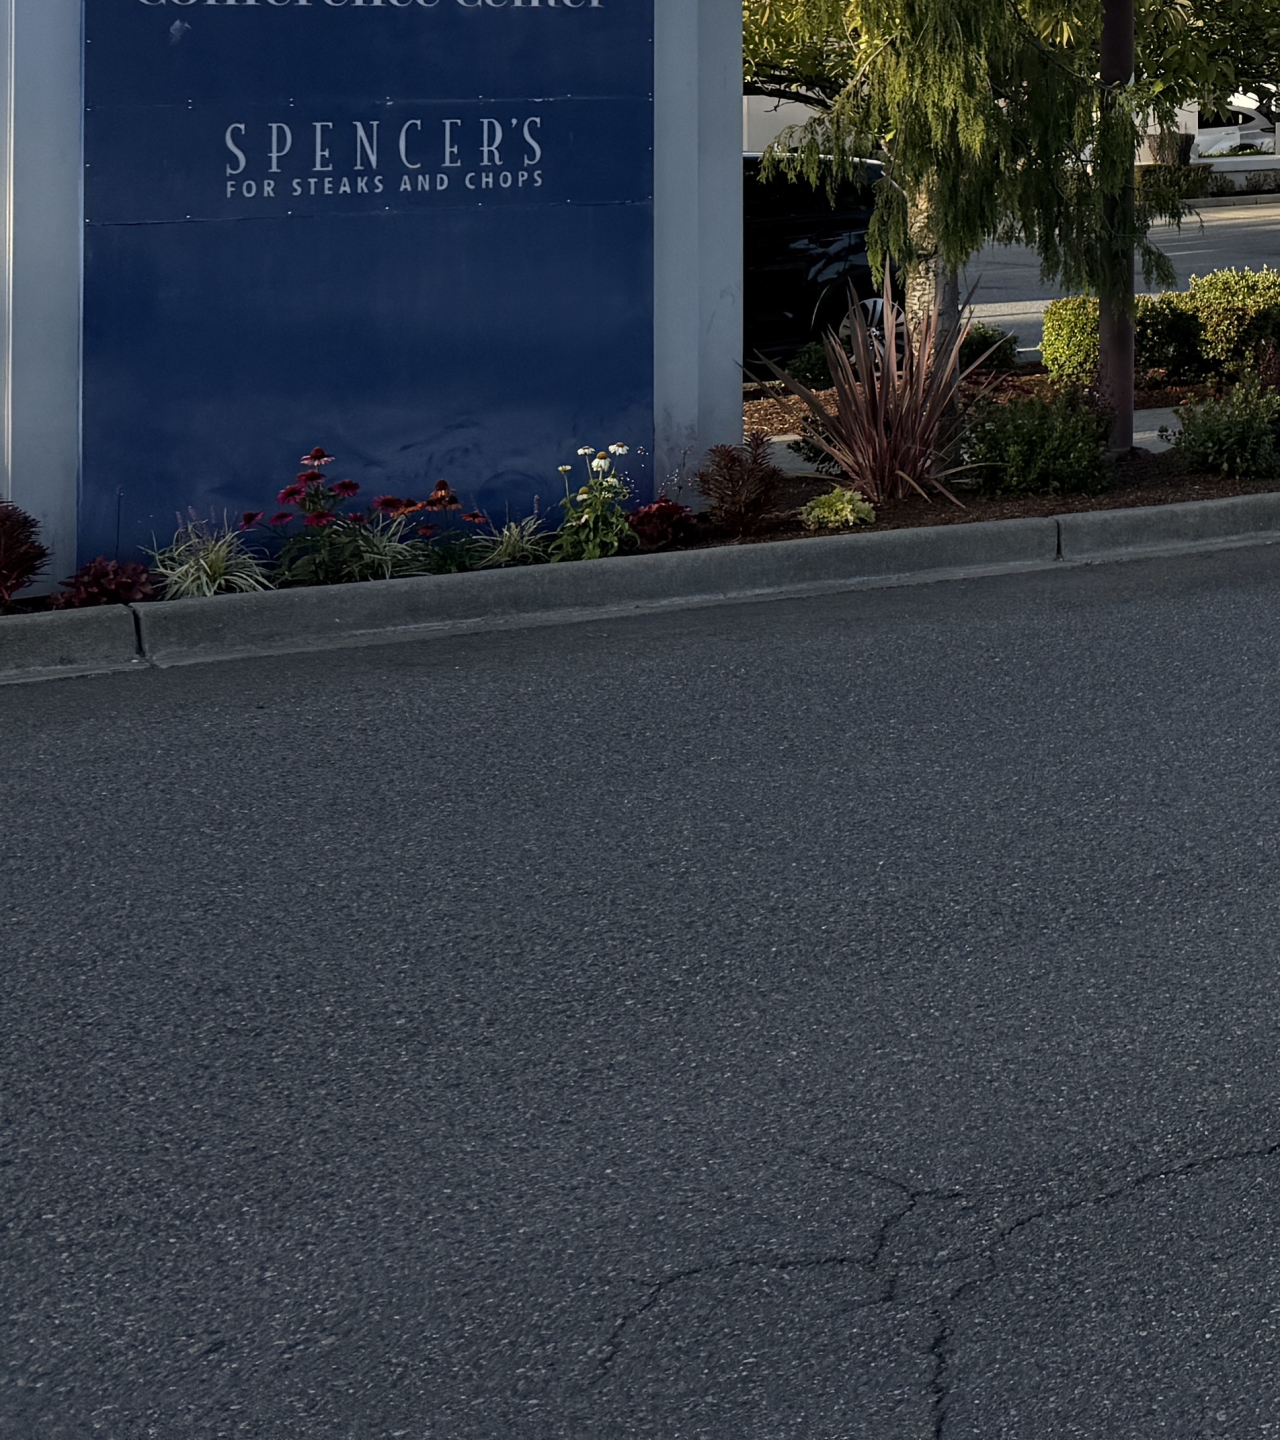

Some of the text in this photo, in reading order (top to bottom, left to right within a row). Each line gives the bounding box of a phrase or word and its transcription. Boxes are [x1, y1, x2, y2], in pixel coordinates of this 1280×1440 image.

[224, 117, 543, 175] SPENCER'S
[226, 170, 544, 198] FOR STEAKS AND CHOPS
